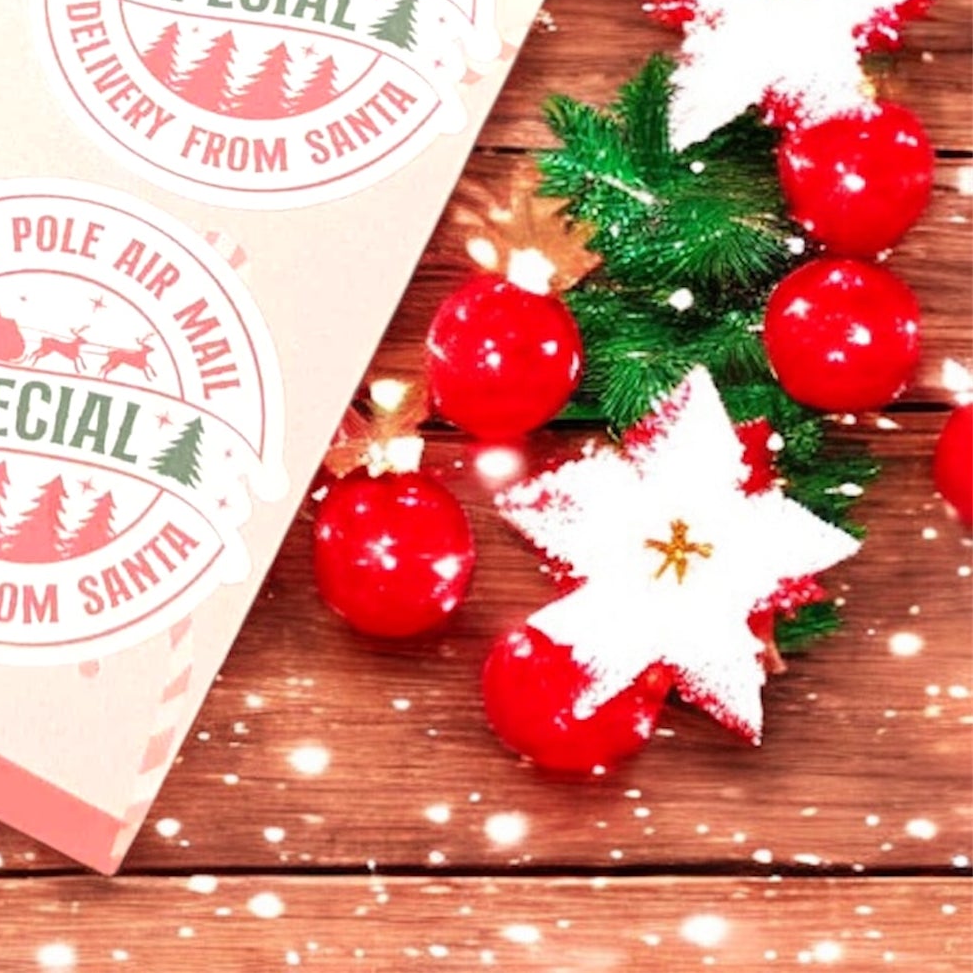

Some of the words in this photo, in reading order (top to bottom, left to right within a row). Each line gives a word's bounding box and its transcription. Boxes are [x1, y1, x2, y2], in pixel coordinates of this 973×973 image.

[66, 0, 176, 140] DELIVERY
[181, 124, 288, 173] FROM
[304, 81, 418, 164] SANTA
[12, 215, 105, 258] POLE
[113, 238, 181, 300] AIR
[173, 298, 241, 399] MAIL
[78, 521, 200, 615] SANTA
